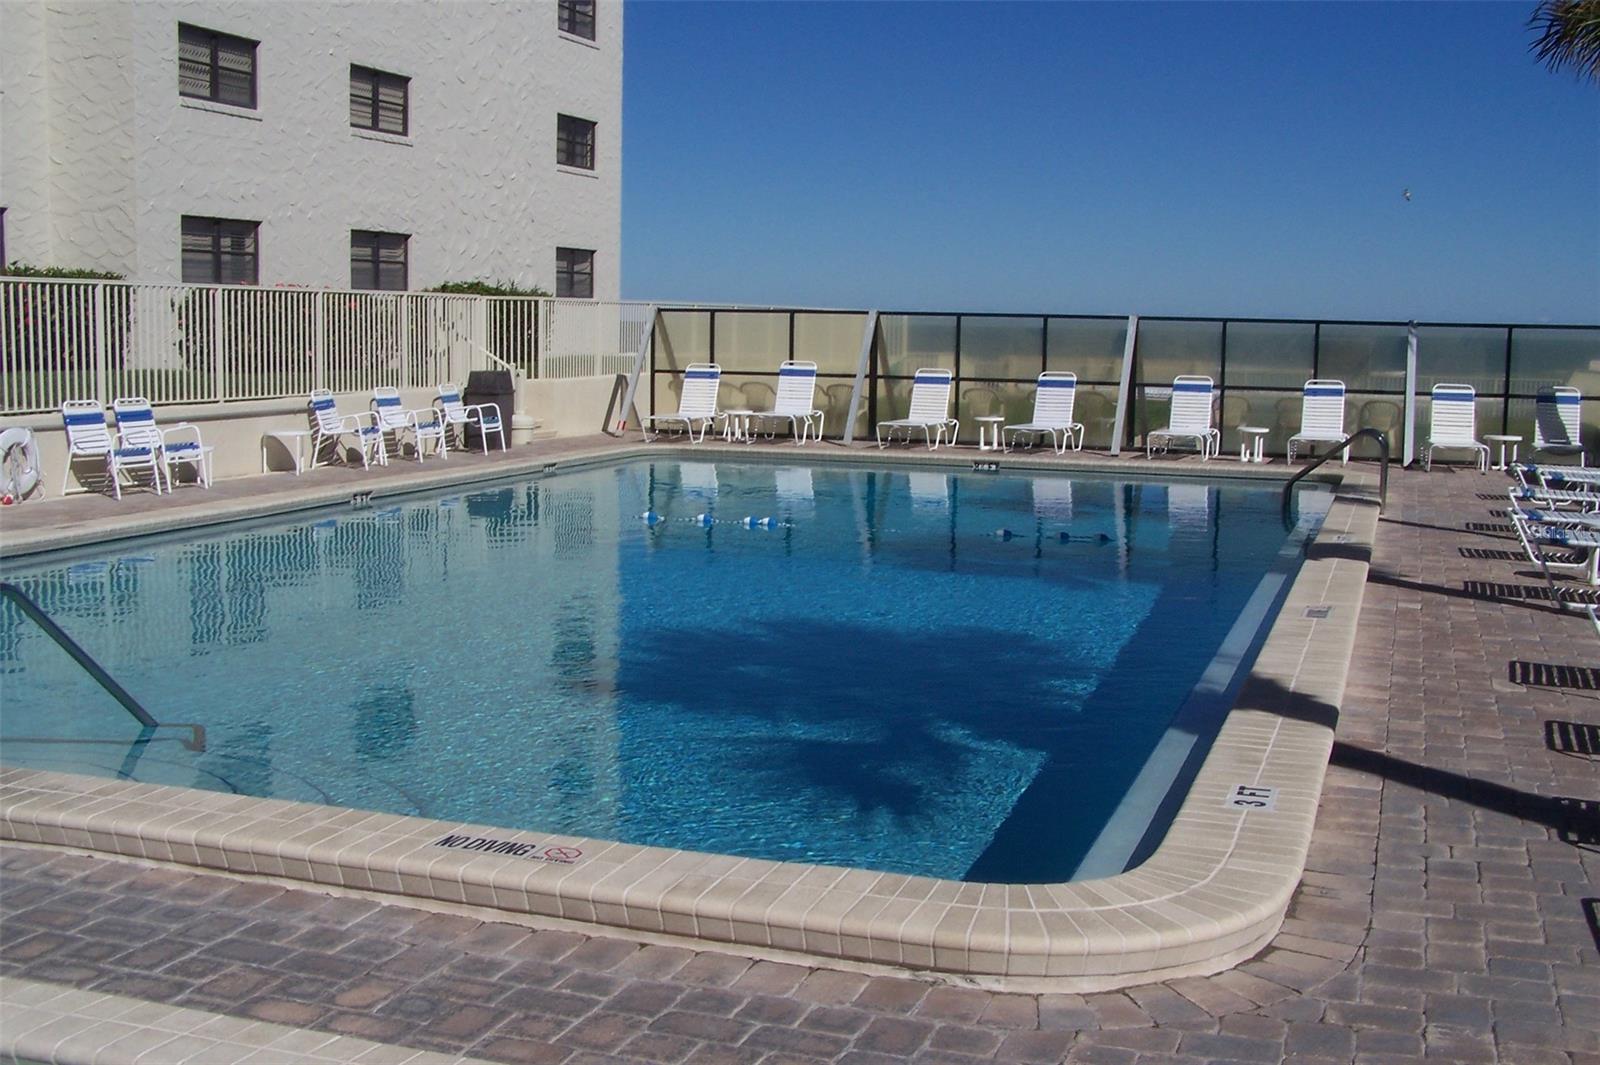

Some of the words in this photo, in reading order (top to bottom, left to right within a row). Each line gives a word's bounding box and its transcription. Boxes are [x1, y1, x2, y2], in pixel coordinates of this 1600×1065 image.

[1236, 786, 1271, 798] FT
[434, 834, 470, 848] NO
[463, 838, 536, 857] DIVING
